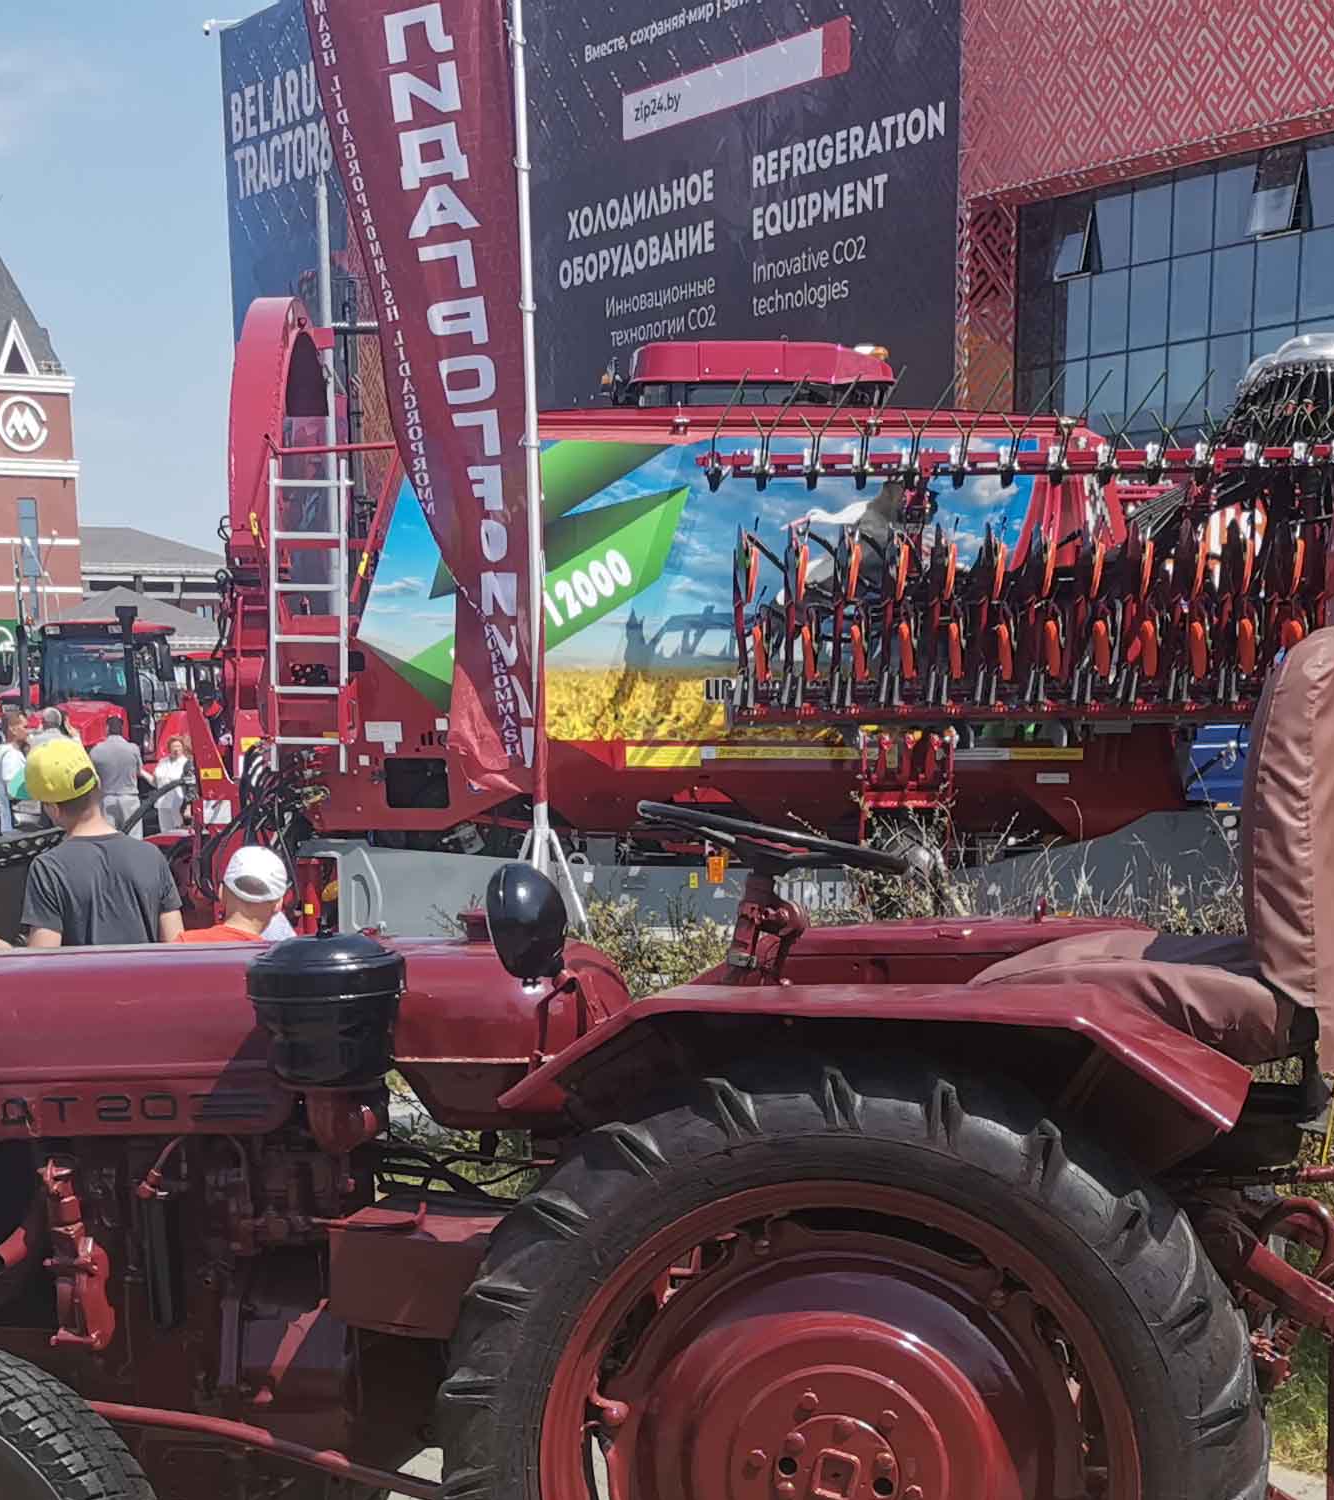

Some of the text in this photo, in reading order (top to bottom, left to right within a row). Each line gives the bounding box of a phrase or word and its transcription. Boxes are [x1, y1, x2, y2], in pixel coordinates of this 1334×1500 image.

[584, 2, 714, 63] Вместе, сохраняя мир
[634, 92, 682, 121] zip24.by
[752, 102, 946, 188] REFRIGERATION
[567, 169, 714, 241] ХОЛОДИЛЬНОЕ
[752, 174, 888, 240] EQUIPMENT
[559, 220, 715, 289] ОБОРУДОВАНИЕ
[753, 235, 867, 284] Innovative CO2
[605, 276, 715, 319] Инновационные
[753, 279, 849, 317] technologies
[610, 316, 685, 348] технологии
